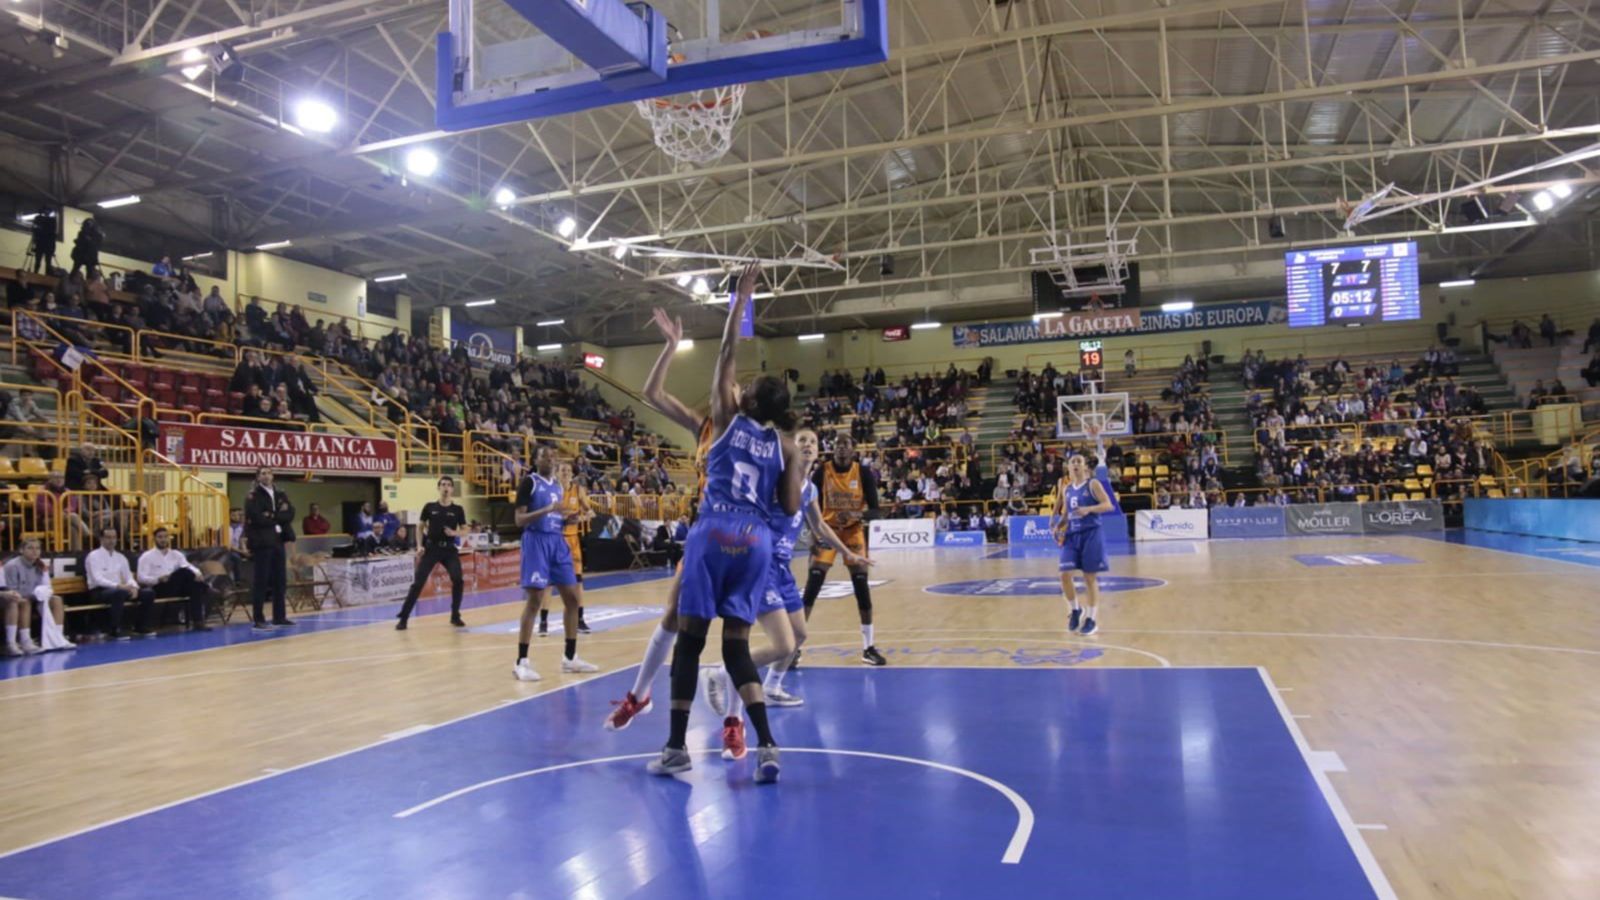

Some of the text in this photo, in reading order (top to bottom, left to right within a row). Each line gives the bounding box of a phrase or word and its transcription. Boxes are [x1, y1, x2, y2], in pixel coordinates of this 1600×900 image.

[1331, 259, 1371, 275] 7 7
[1332, 290, 1373, 305] 05:12
[1135, 306, 1264, 332] EINAS DE EUROPA
[1334, 306, 1343, 318] 0
[1364, 304, 1371, 316] 1
[1044, 317, 1066, 335] LA
[1069, 314, 1134, 332] GACETA
[1082, 352, 1100, 366] 19
[220, 428, 377, 456] SALAMANCA
[191, 448, 394, 471] PATRIMONIO DE LA HUMANIDAD
[731, 461, 760, 503] 0
[1070, 496, 1079, 508] 6
[880, 531, 929, 544] ASTOR
